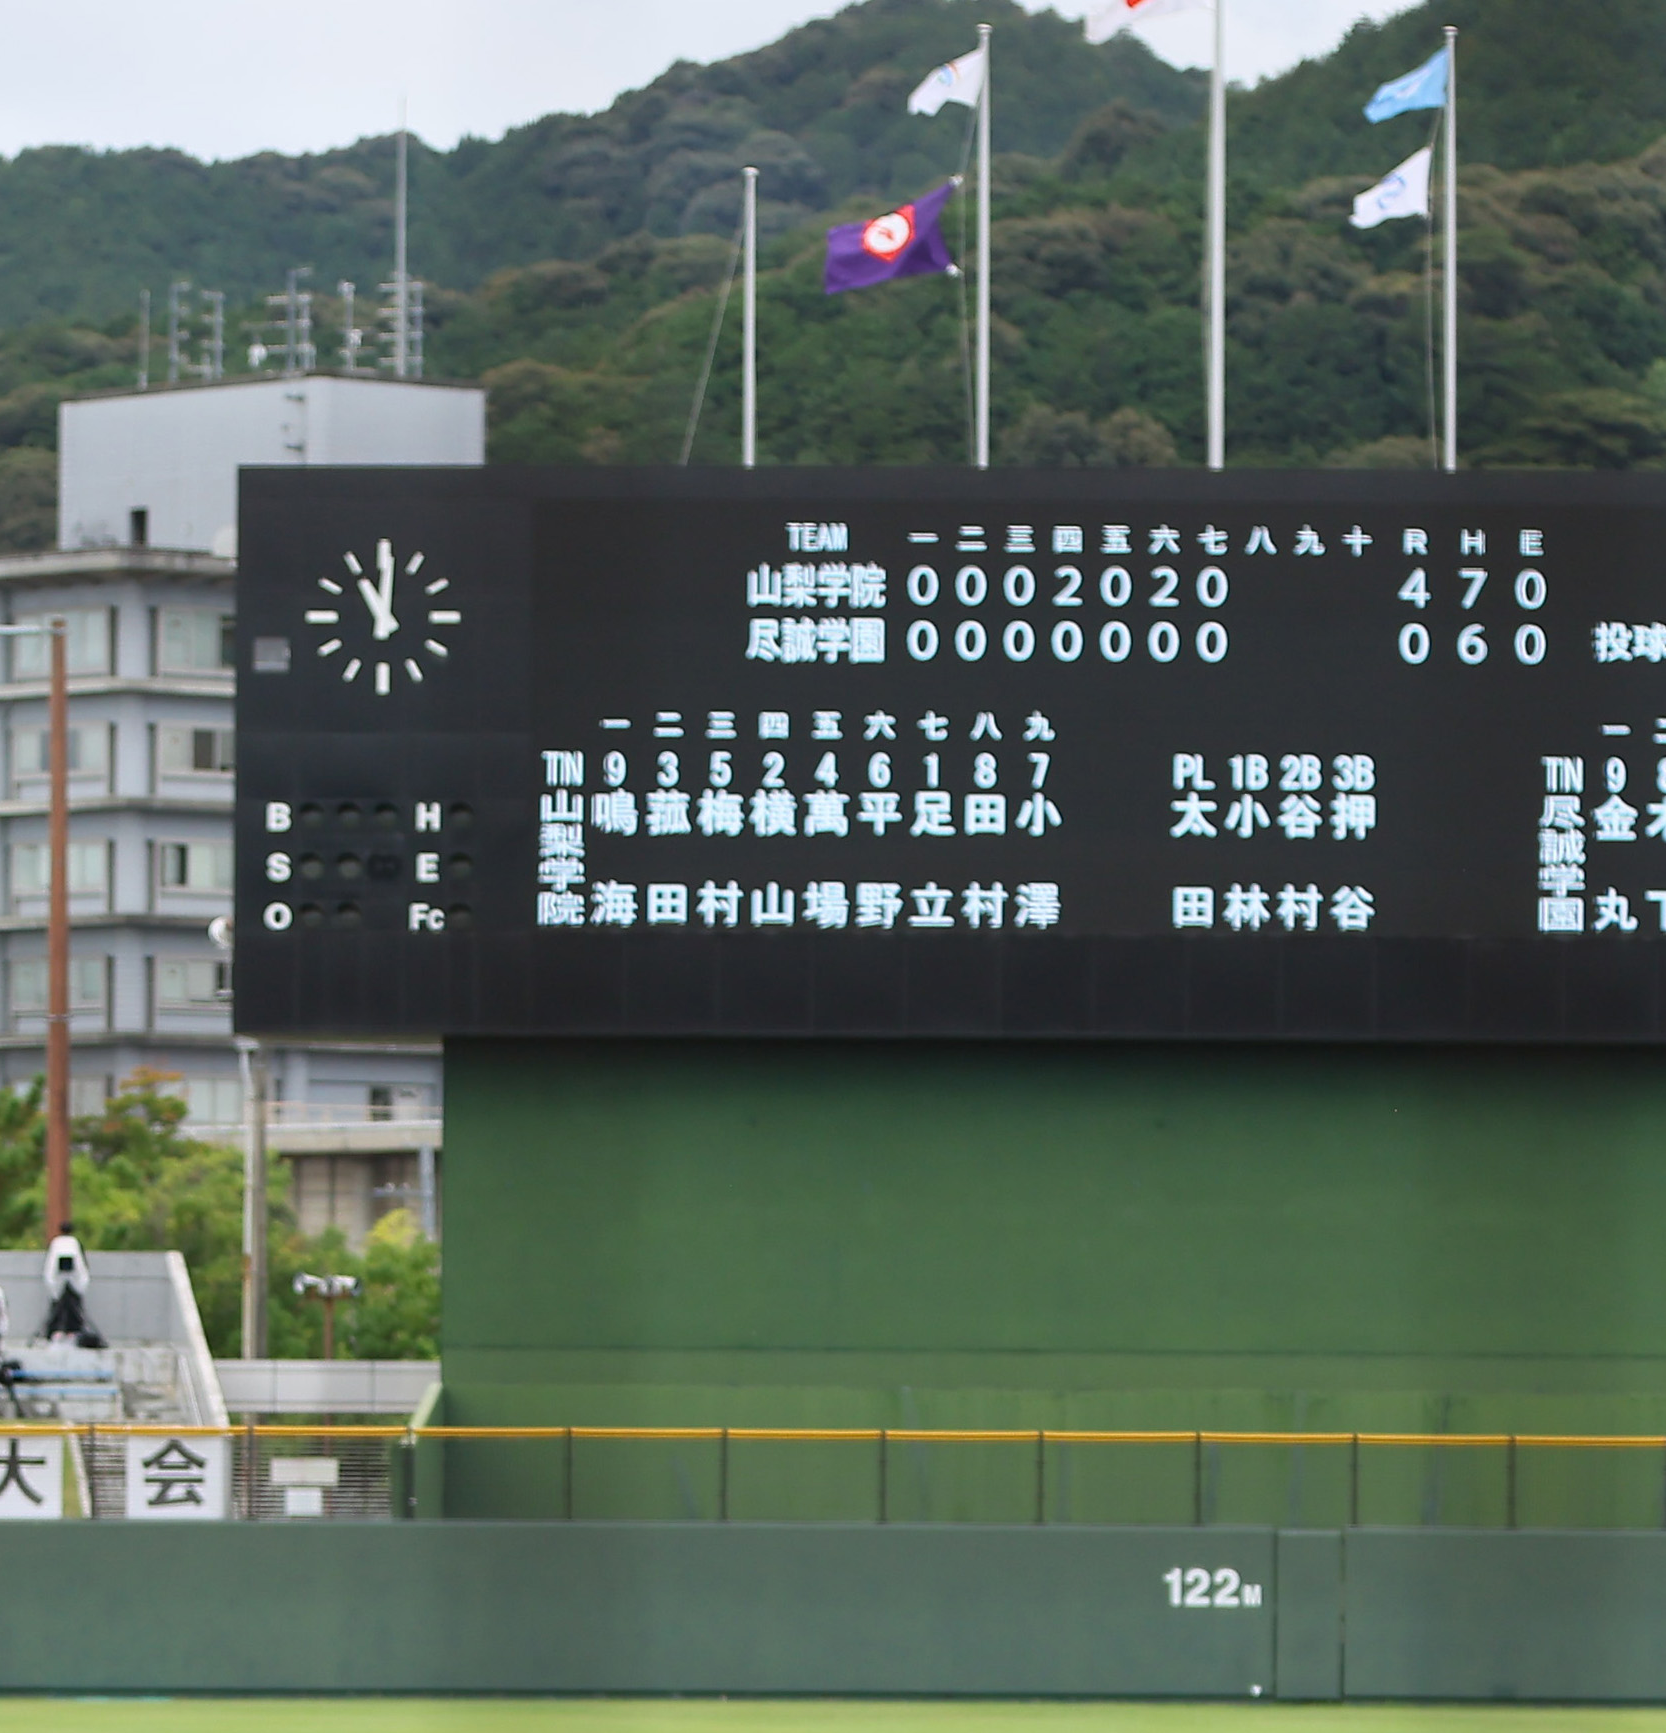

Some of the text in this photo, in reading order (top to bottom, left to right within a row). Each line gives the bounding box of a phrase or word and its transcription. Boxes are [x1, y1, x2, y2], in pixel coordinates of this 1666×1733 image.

[785, 522, 848, 553] TEAM
[955, 525, 988, 552] 二
[1003, 524, 1036, 553] 三
[1052, 525, 1083, 554] 四
[1100, 524, 1133, 554] 五
[1148, 524, 1181, 555] 六
[1196, 524, 1229, 556] 七
[1244, 525, 1277, 555] 八
[1293, 524, 1326, 556] 九
[1341, 524, 1373, 557] 十
[1403, 528, 1428, 555] R
[1460, 528, 1486, 556] H
[1519, 529, 1544, 557] E
[746, 560, 1547, 610] 山梨学院 0 0 0 2 0 2 0 4 7 0
[745, 615, 1547, 665] 尽誠学園 0 0 0 0 0 0 0 0 6 0
[653, 711, 685, 738] 二
[705, 711, 737, 739] 三
[758, 711, 790, 740] 四
[811, 710, 843, 740] 五
[863, 709, 897, 741] 六
[916, 710, 949, 741] 七
[969, 711, 1003, 741] 八
[1022, 710, 1056, 742] 九
[602, 750, 627, 787] 9
[656, 750, 680, 788] 3
[709, 750, 732, 788] 5
[761, 751, 785, 788] 2
[814, 751, 840, 788] 4
[867, 751, 891, 789] 6
[923, 752, 939, 789] 1
[973, 752, 997, 789] 8
[1028, 752, 1050, 789] 7
[1172, 753, 1376, 792] PL 1B 2B 3B
[1606, 756, 1627, 794] 9
[265, 801, 442, 833] B H
[266, 852, 440, 883] S E
[537, 788, 586, 927] 山梨学院
[1538, 794, 1587, 933] 尽誠学園
[263, 902, 445, 931] O Fc
